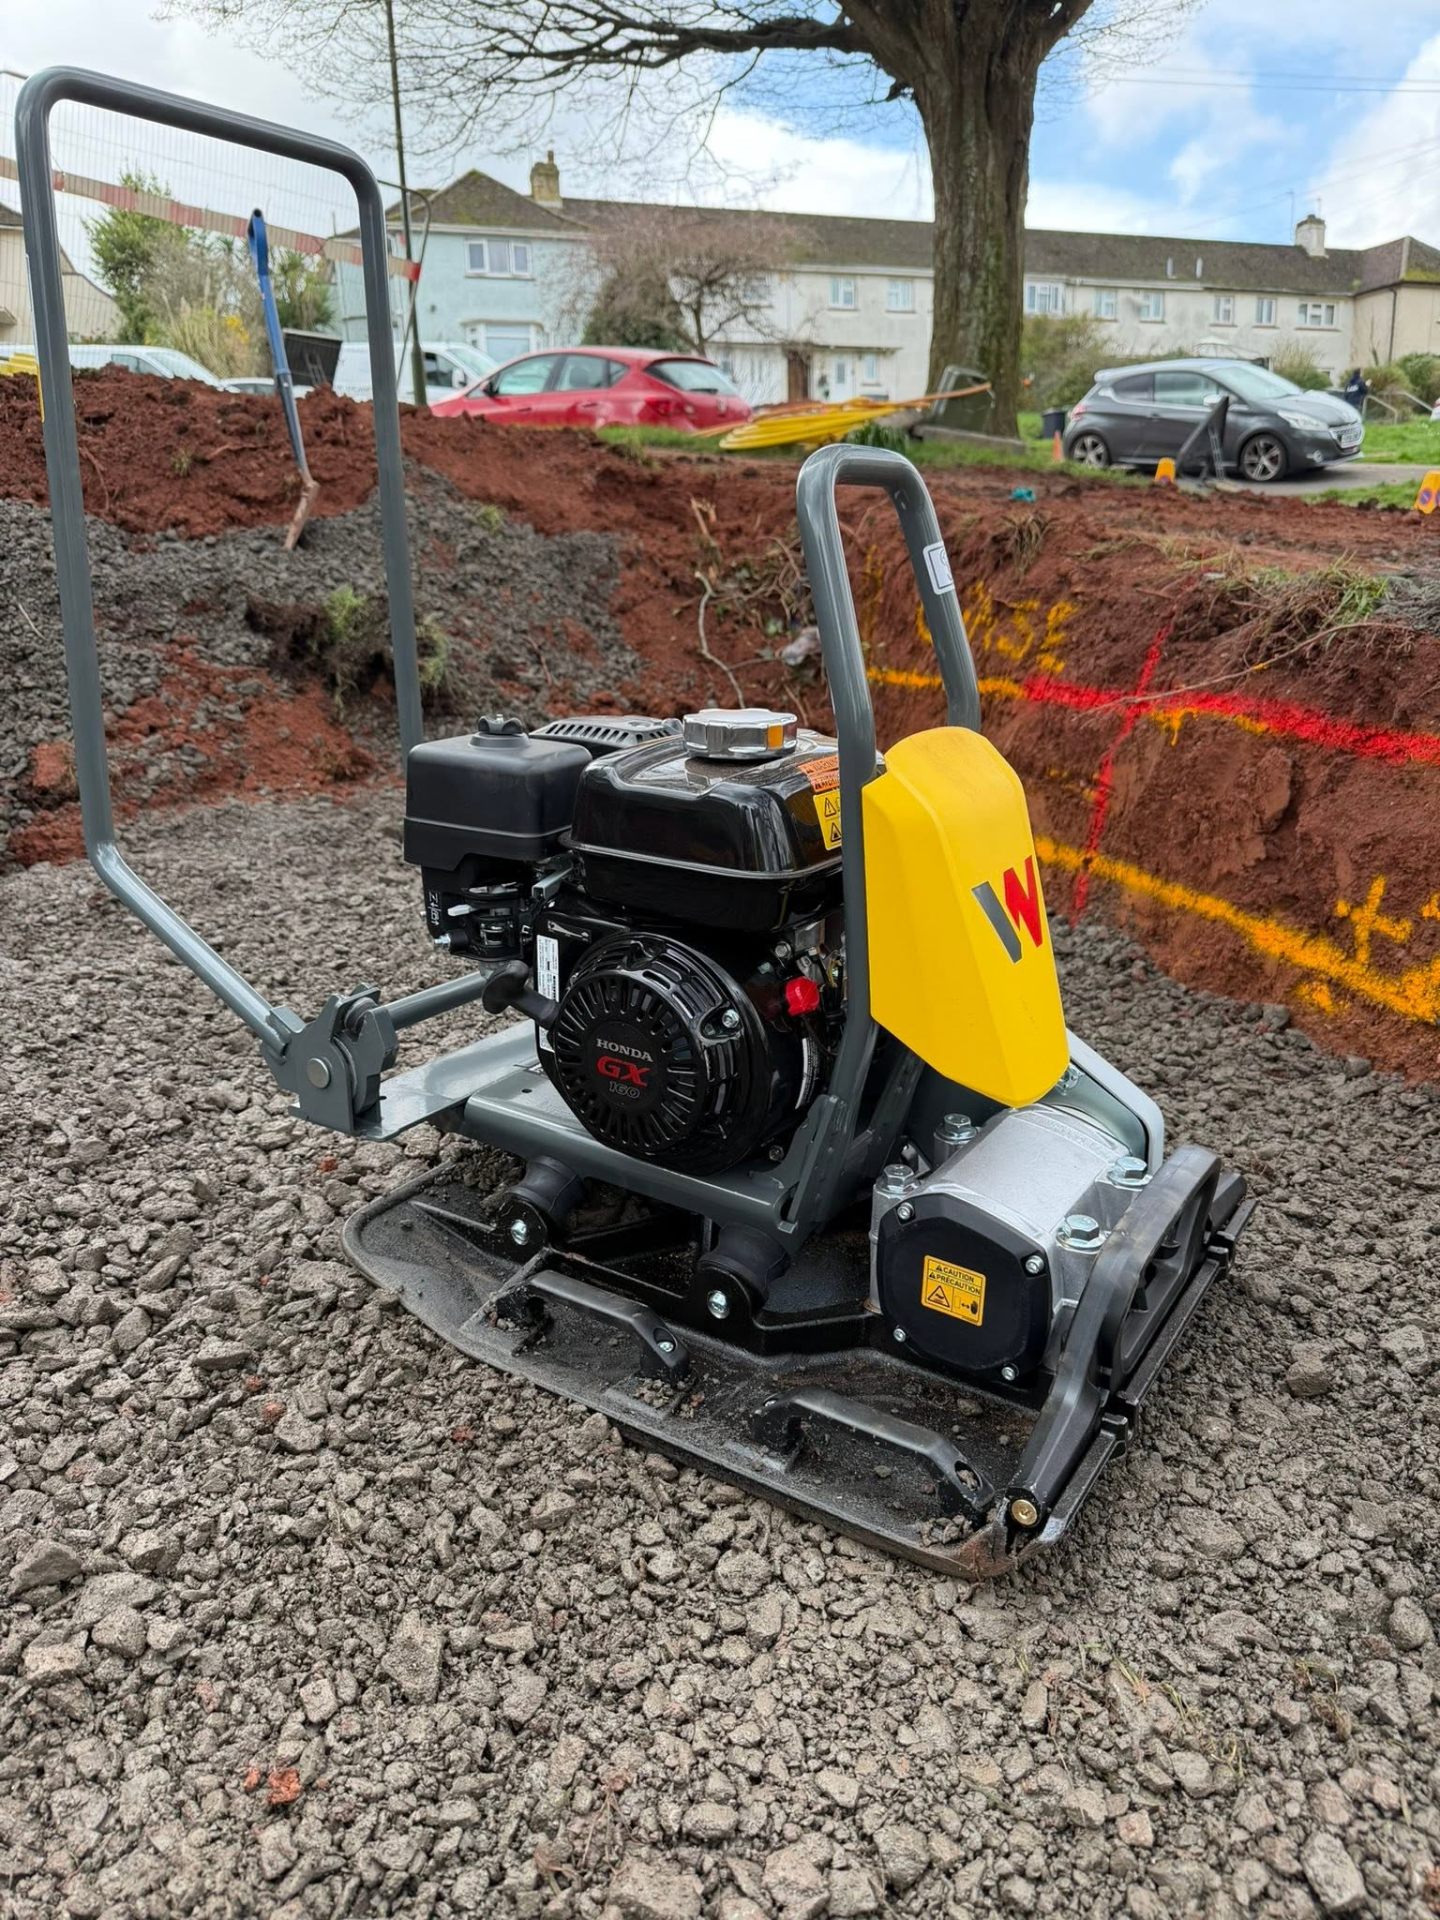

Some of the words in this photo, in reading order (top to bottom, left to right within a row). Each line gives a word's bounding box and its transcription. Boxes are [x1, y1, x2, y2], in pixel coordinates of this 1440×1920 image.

[596, 1038, 654, 1063] HONDA
[596, 1055, 650, 1087] GX
[608, 1080, 641, 1099] 160
[943, 1266, 975, 1283] CAUTION
